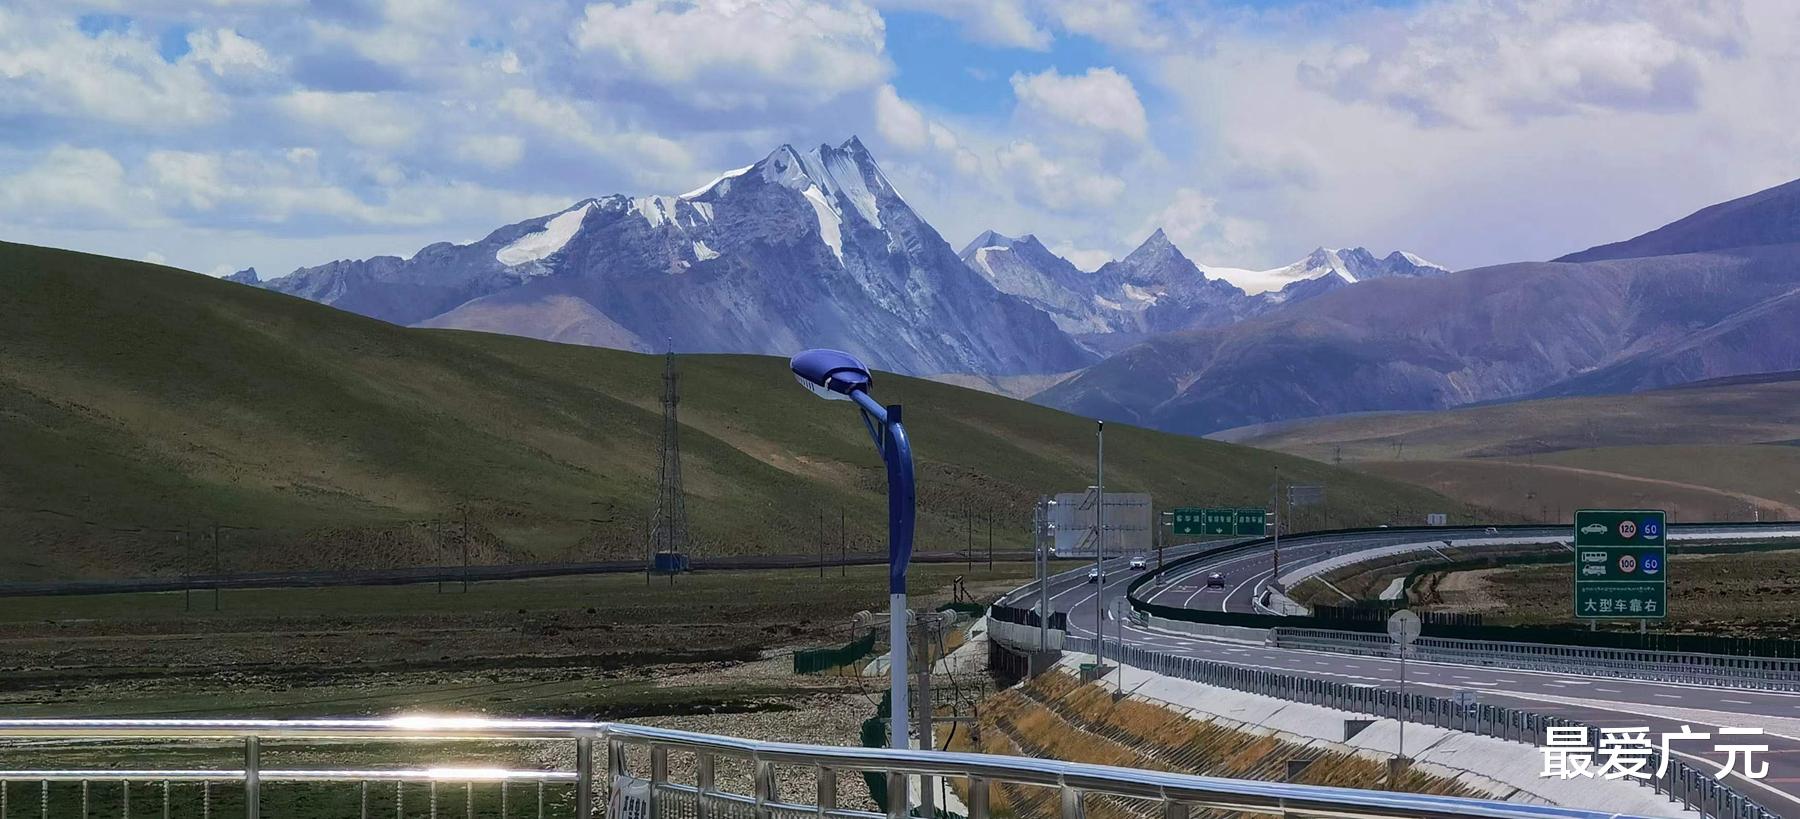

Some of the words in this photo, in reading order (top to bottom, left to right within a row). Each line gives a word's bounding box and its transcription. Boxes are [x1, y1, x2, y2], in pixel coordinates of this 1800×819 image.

[1621, 525, 1635, 534] 120
[1644, 524, 1657, 534] 60
[1621, 559, 1635, 568] 100
[1644, 559, 1658, 569] 60
[1584, 598, 1657, 612] 大型车靠右
